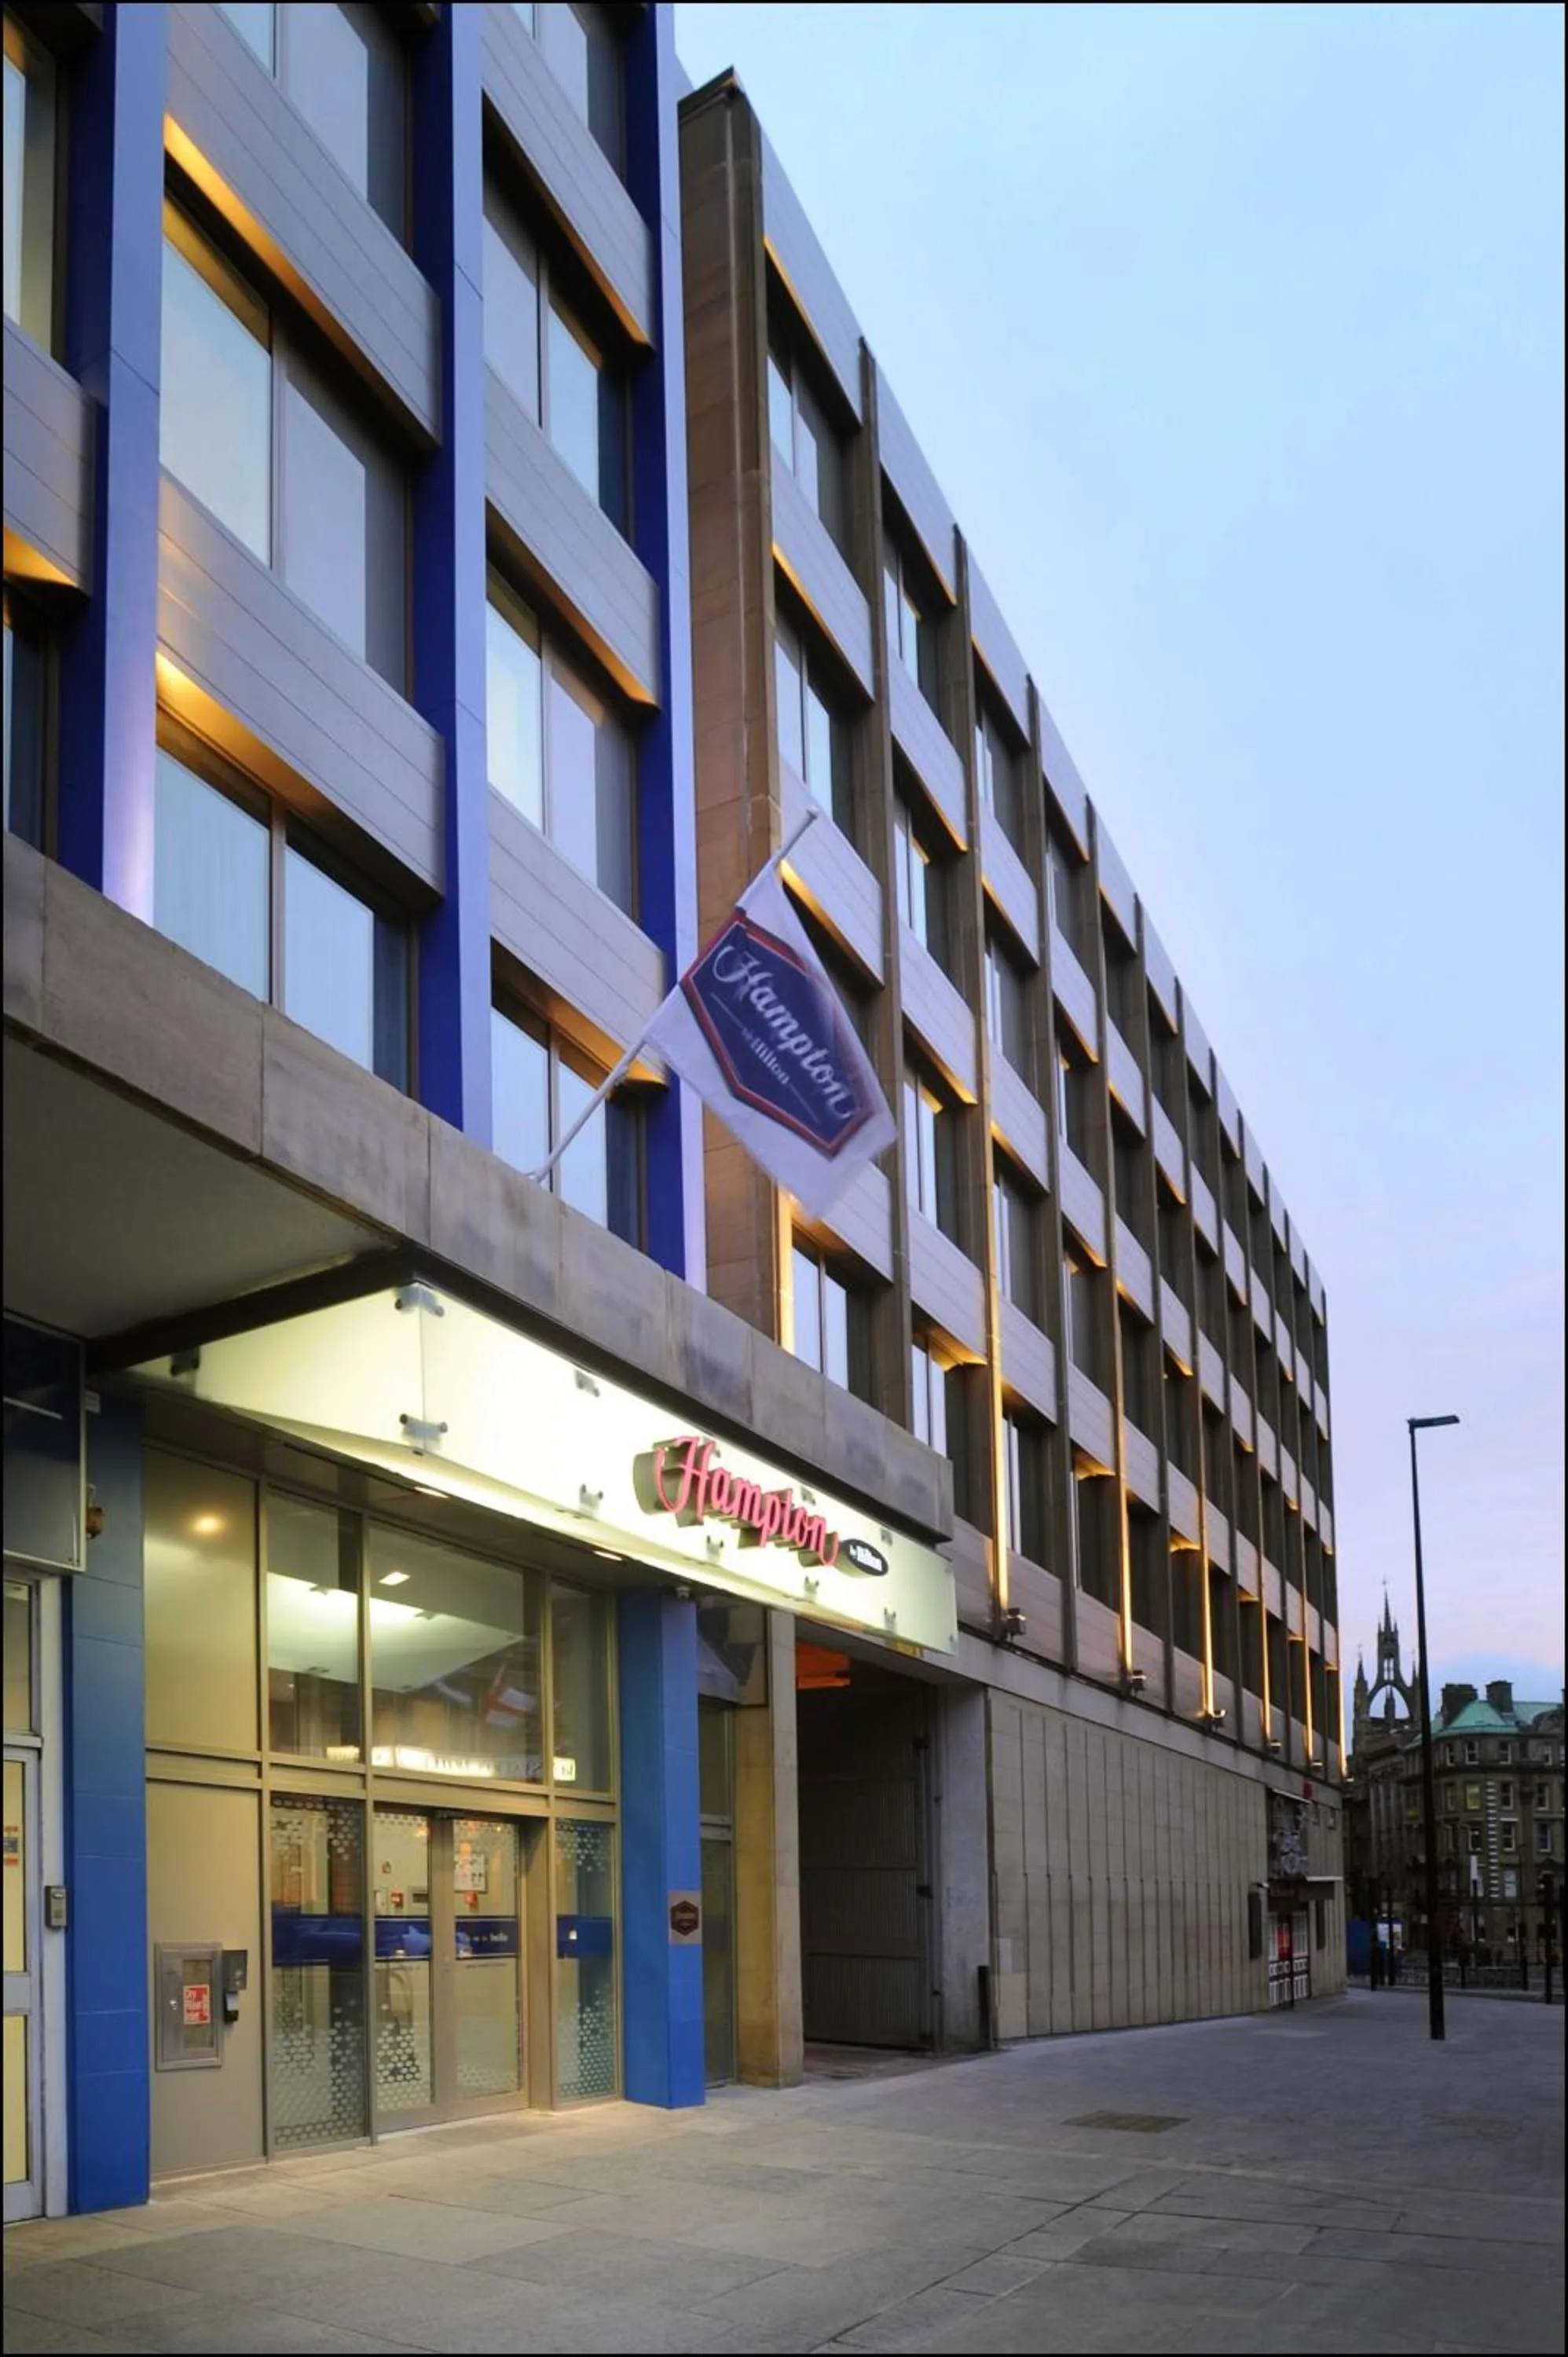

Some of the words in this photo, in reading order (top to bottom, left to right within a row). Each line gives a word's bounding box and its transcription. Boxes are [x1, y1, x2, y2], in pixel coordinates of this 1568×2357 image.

[713, 945, 855, 1119] Hampton
[749, 1037, 790, 1085] Hilton
[654, 1435, 840, 1567] Hampton
